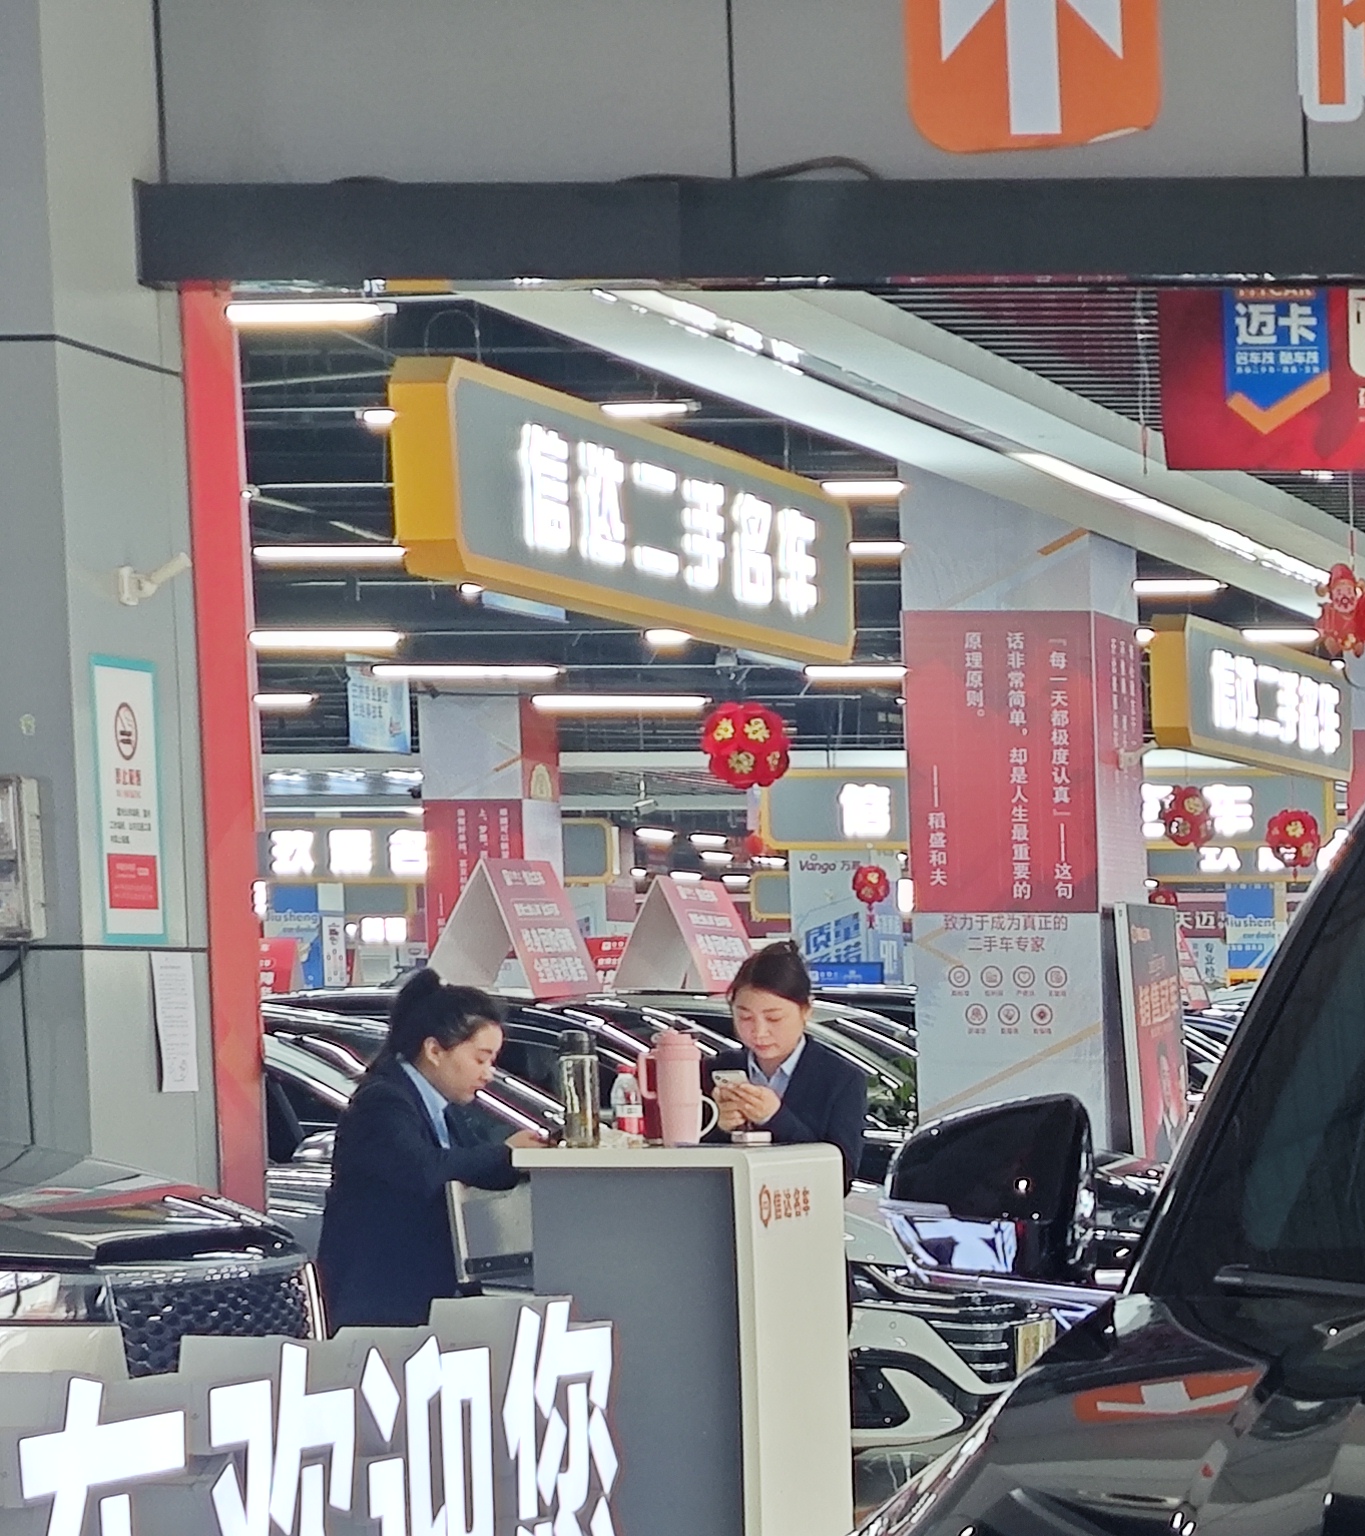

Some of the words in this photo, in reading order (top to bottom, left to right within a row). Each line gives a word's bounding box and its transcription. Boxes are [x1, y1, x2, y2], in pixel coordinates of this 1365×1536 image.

[1235, 303, 1318, 346] 迈卡
[944, 914, 1068, 931] 致力于成为真正的
[968, 936, 1046, 952] 二手车专家
